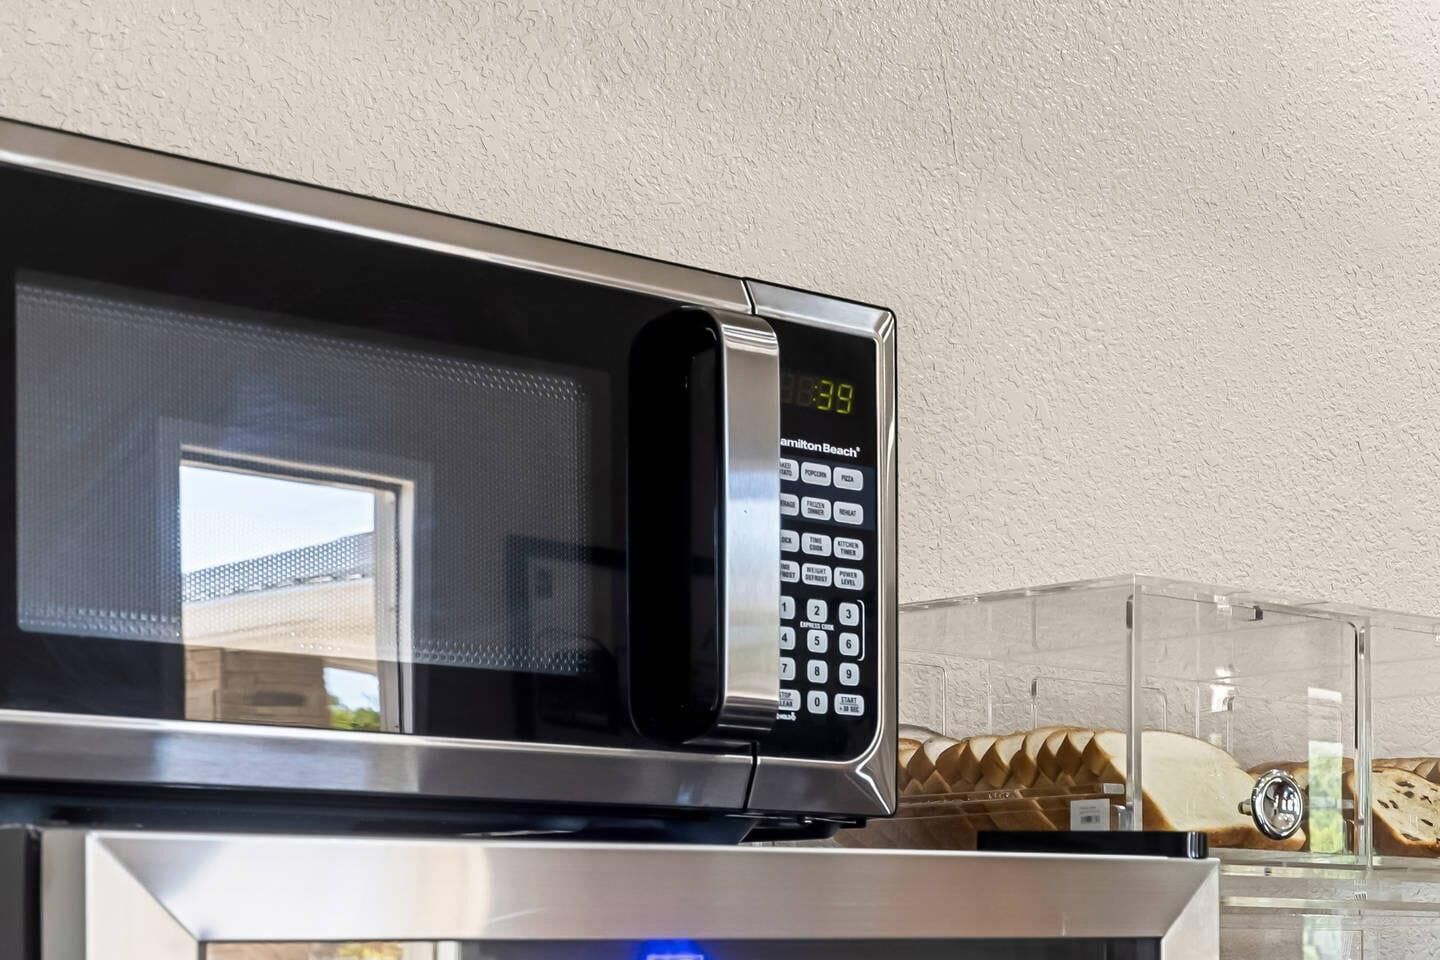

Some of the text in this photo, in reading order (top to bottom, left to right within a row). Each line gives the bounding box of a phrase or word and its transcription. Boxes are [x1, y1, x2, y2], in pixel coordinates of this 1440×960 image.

[780, 438, 858, 458] amilton Beach
[806, 567, 826, 575] WEIGHT
[782, 602, 787, 612] 1
[814, 605, 821, 616] 2
[845, 609, 852, 619] 3
[781, 633, 788, 643] 4
[814, 636, 821, 646] 5
[845, 639, 852, 649] 6
[782, 663, 788, 674] 7
[814, 666, 821, 677] 8
[845, 669, 852, 679] 9
[814, 697, 820, 707] 0
